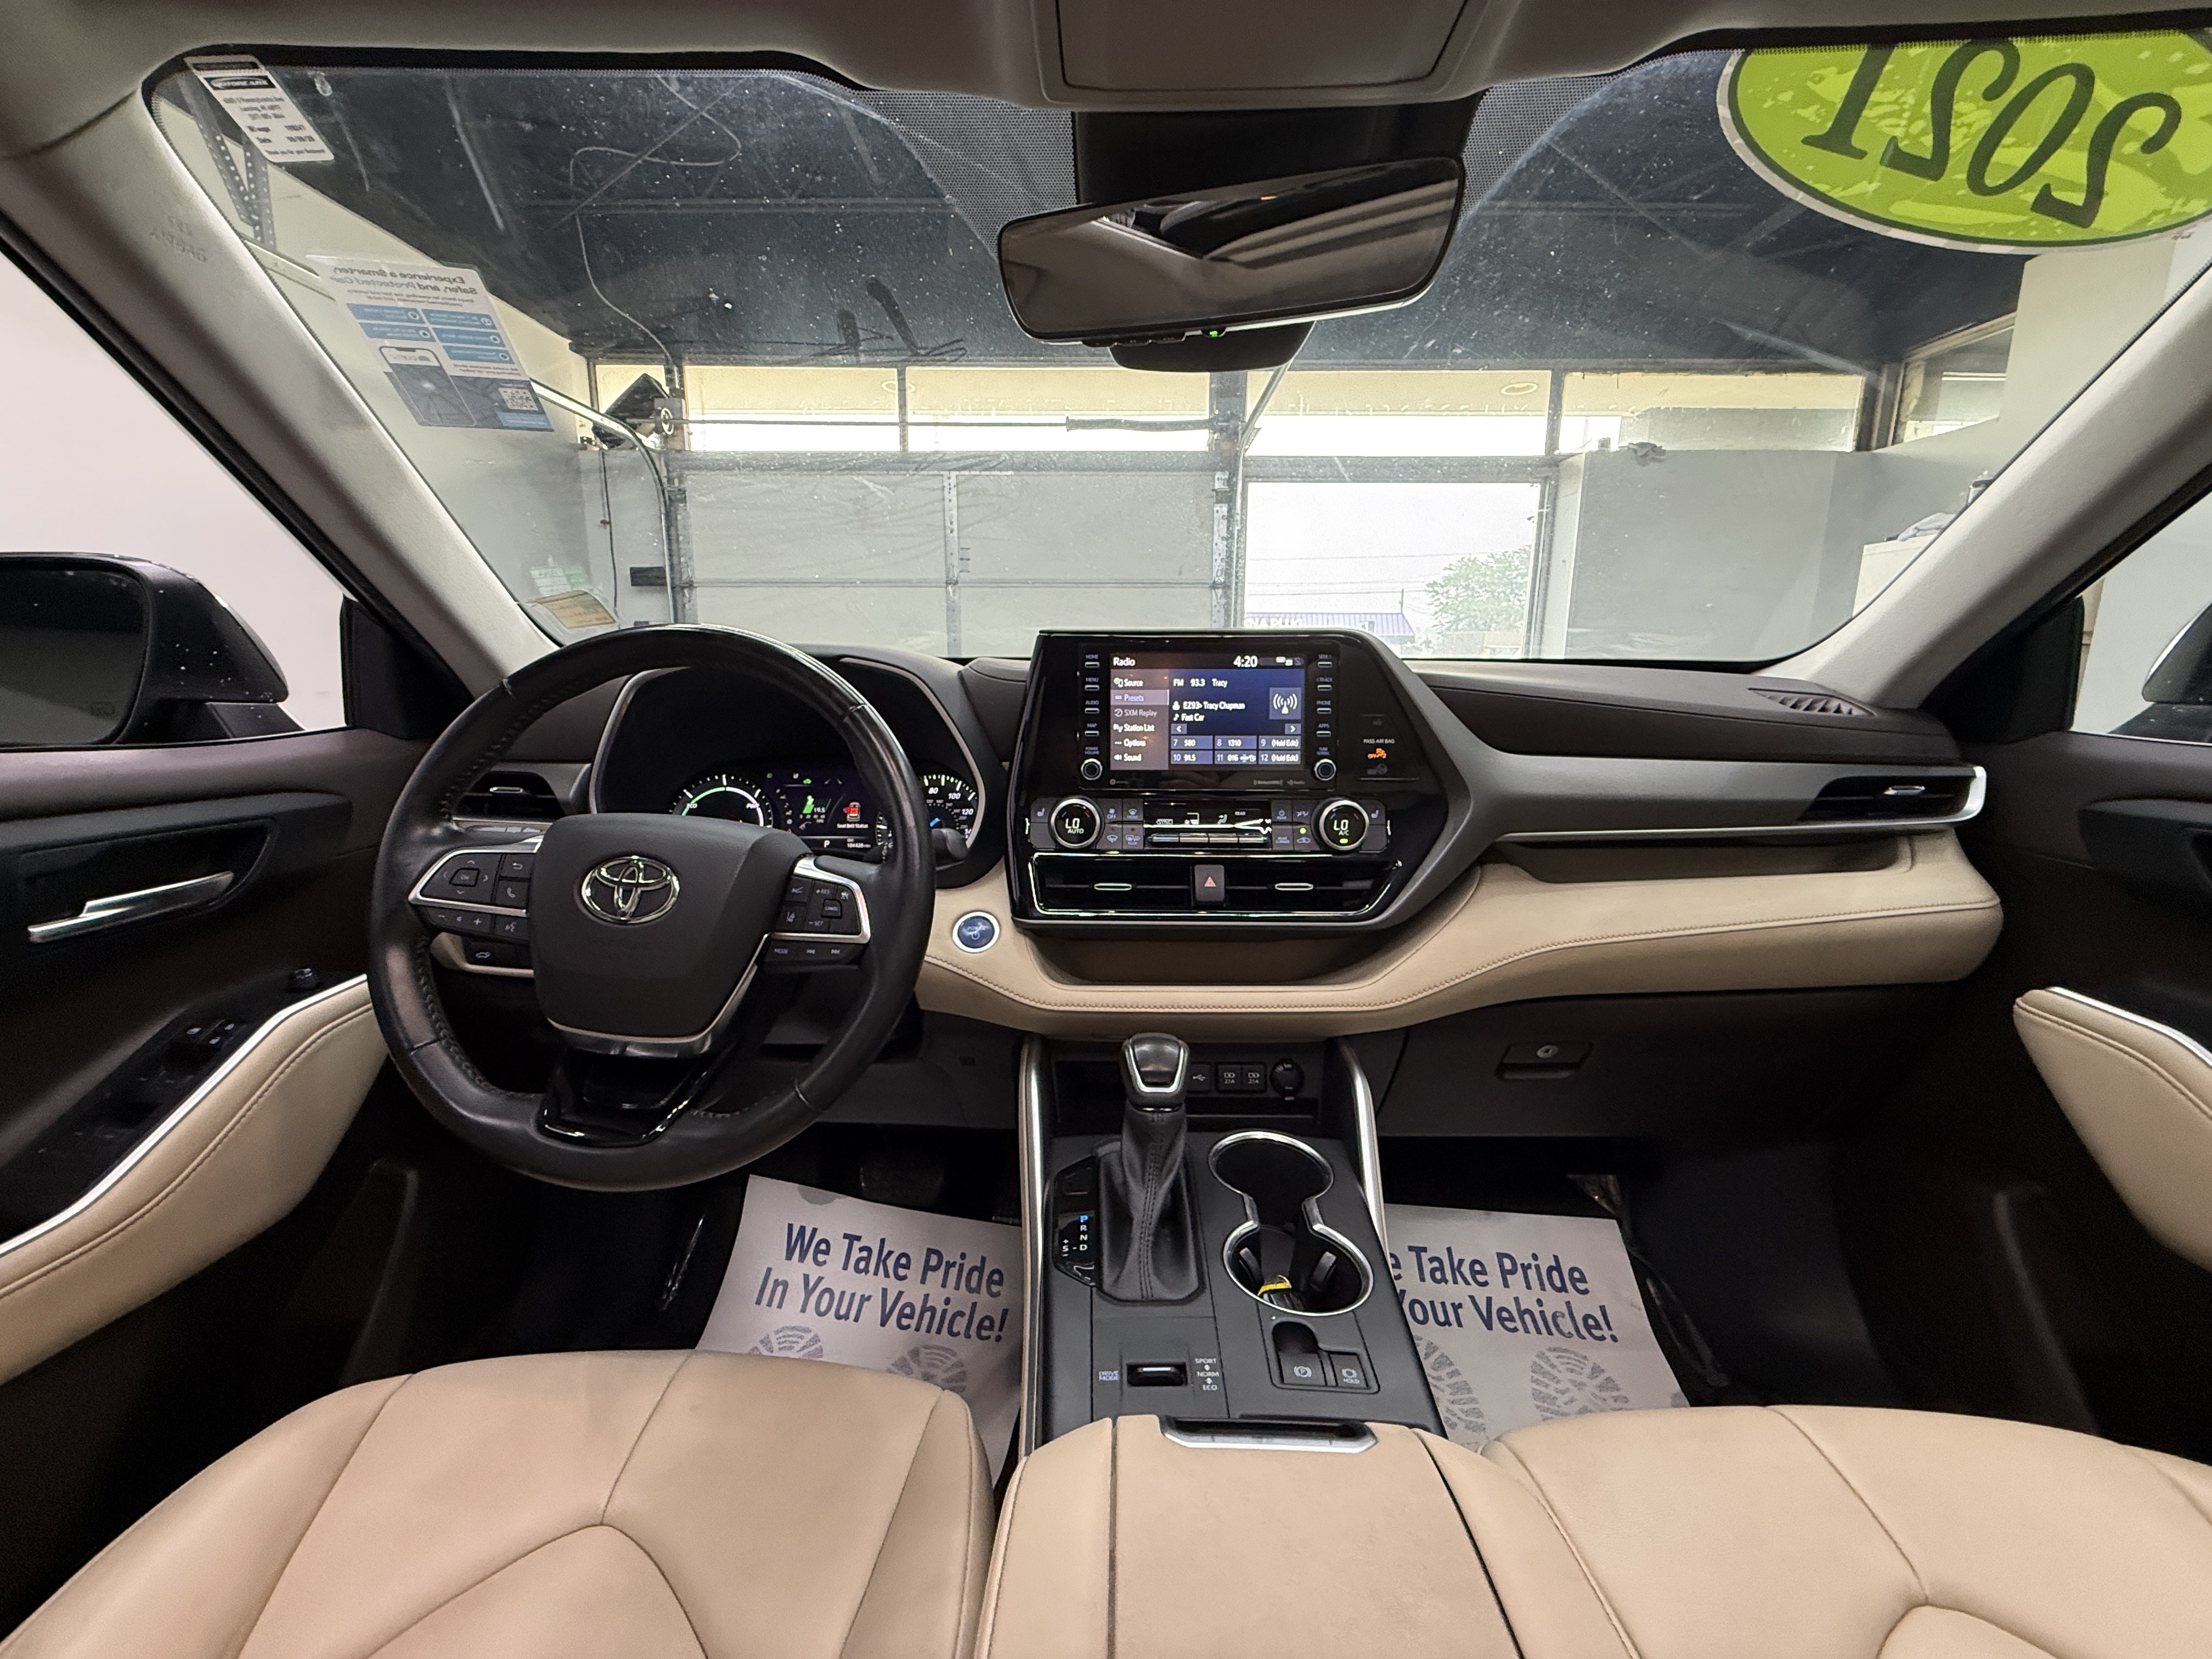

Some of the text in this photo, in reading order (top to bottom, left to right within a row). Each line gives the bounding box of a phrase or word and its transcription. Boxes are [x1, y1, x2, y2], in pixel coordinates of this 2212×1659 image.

[1113, 657, 1136, 667] Radio
[1233, 656, 1259, 668] 4:20
[1190, 679, 1206, 687] 93.3
[1124, 694, 1144, 702] Presets
[1203, 702, 1219, 711] Tracy
[1219, 702, 1246, 711] Chapman
[1138, 709, 1158, 719] Replay
[1181, 714, 1206, 722] Fast Car
[1124, 724, 1155, 732] Station List
[1124, 738, 1147, 748] Options
[1124, 754, 1142, 762] Sound
[1065, 818, 1080, 829] LO
[1333, 820, 1348, 831] LO
[824, 840, 831, 848] P
[1080, 1215, 1088, 1223] P
[785, 1222, 1005, 1299] We Take Pride
[1388, 1245, 1590, 1295] e Take Pride
[754, 1266, 1009, 1343] In Your Vehicle!
[1468, 1294, 1619, 1343] Vehicle!
